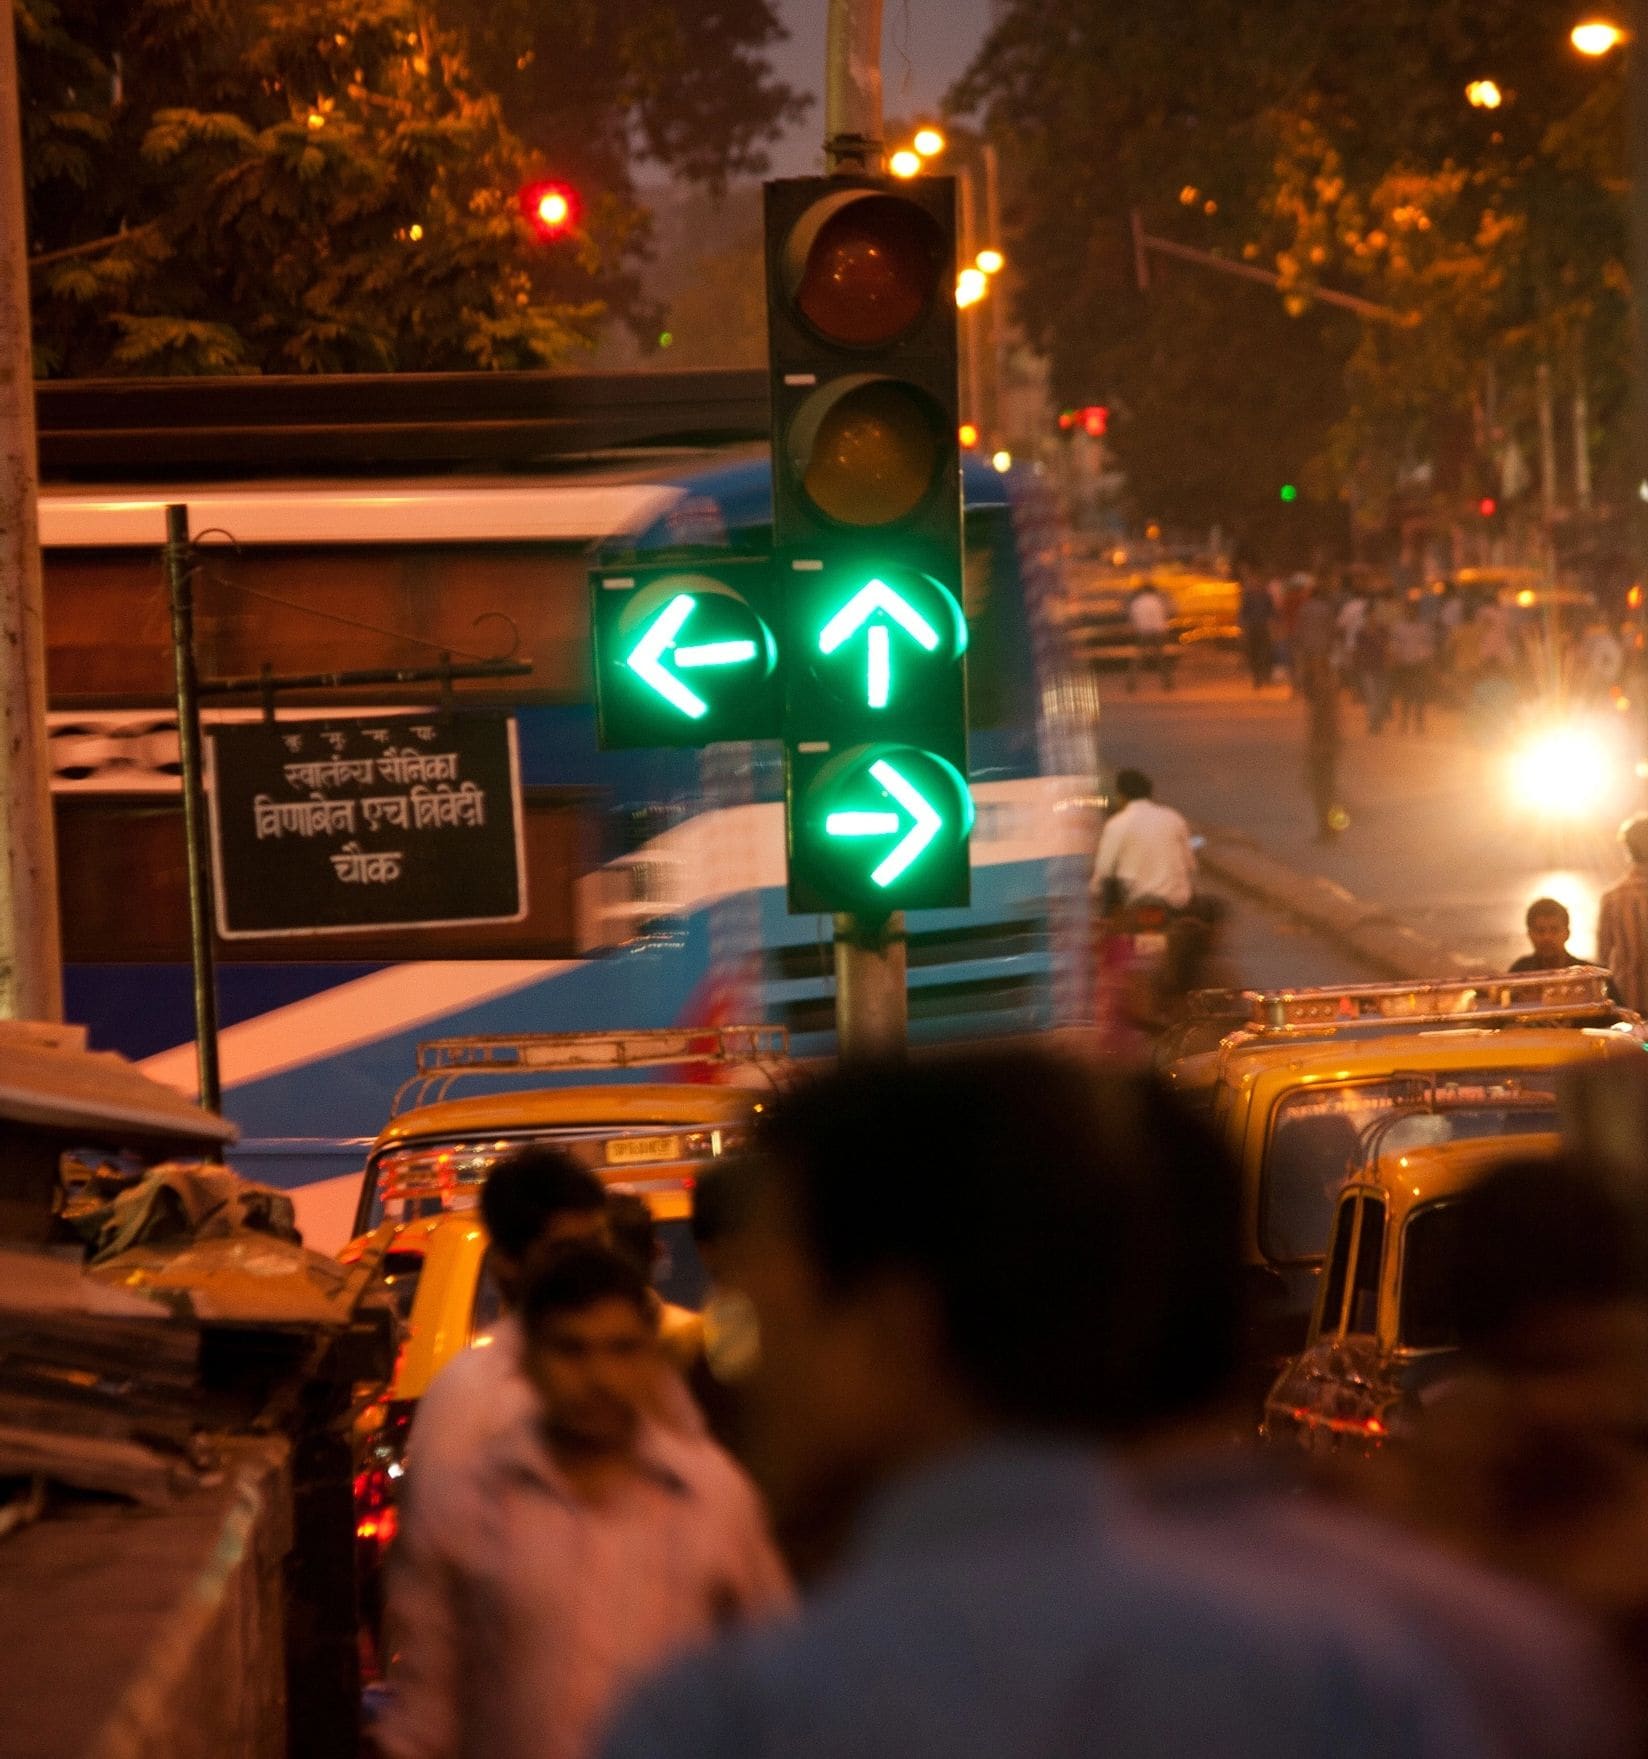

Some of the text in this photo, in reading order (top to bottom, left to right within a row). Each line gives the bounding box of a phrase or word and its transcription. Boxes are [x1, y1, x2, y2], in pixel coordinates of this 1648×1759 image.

[361, 797, 409, 831] एच
[411, 781, 485, 828] त्रिवेदी
[330, 842, 402, 883] चौक
